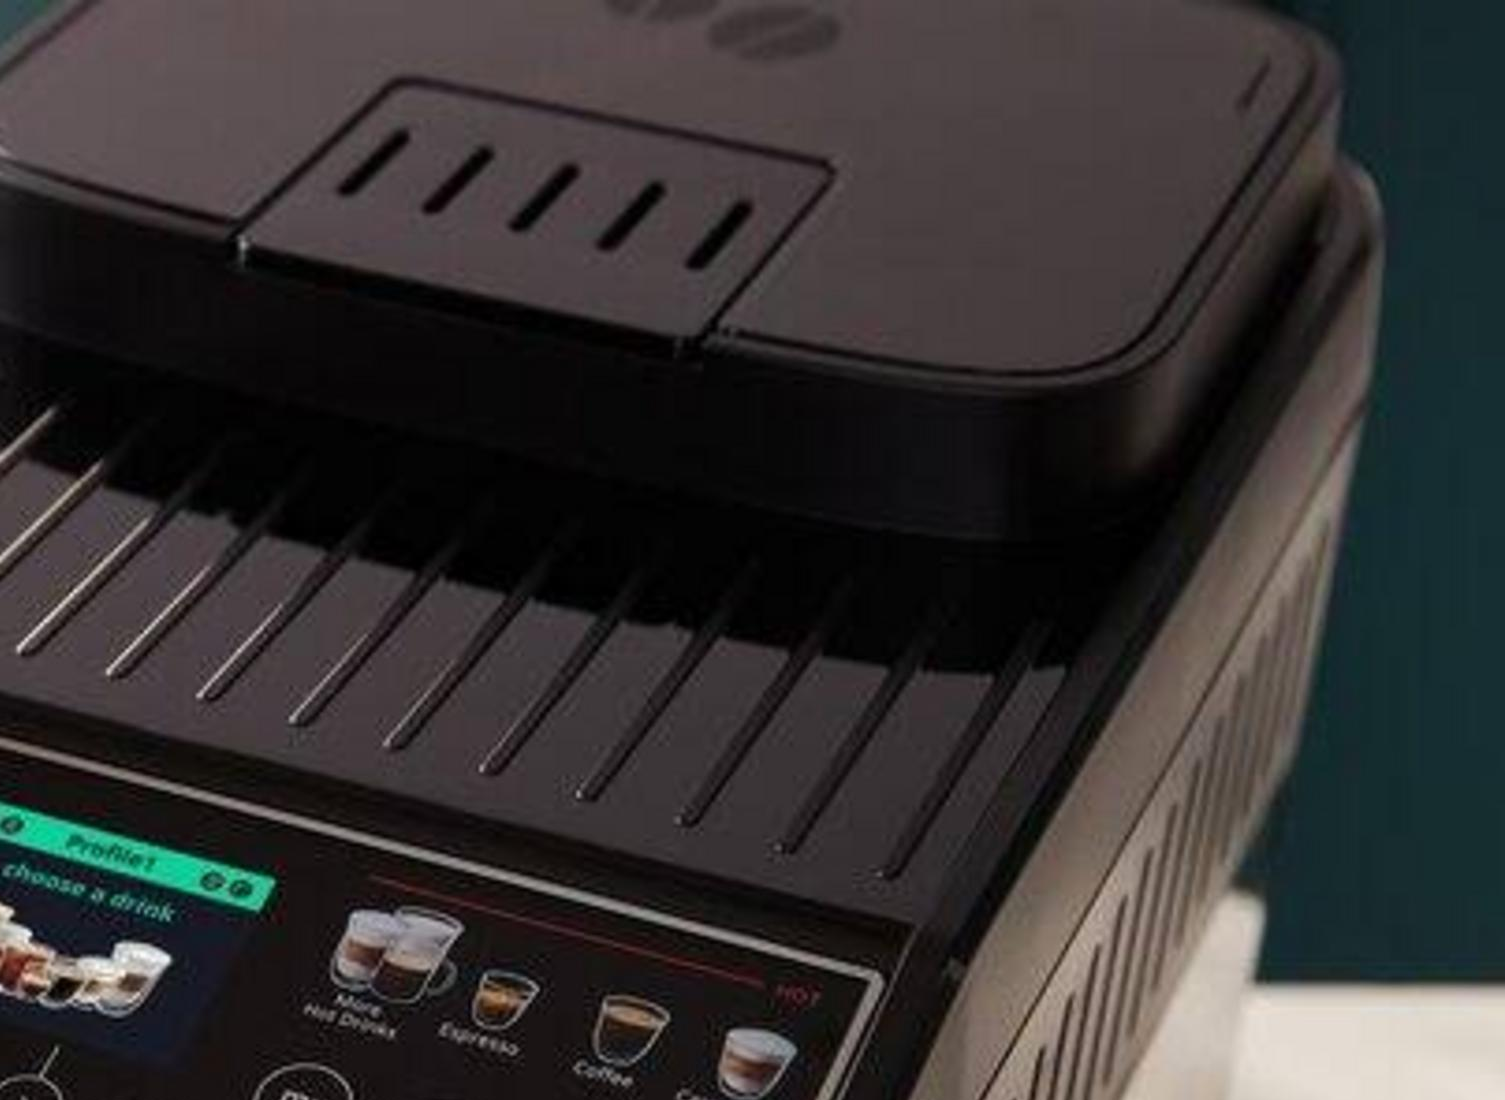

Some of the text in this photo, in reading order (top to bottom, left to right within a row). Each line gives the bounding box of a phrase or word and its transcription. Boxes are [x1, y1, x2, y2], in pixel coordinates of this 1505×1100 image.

[1, 860, 86, 898] choose
[109, 891, 176, 924] drink
[438, 1020, 521, 1058] Espresso
[572, 1058, 634, 1089] Coffee
